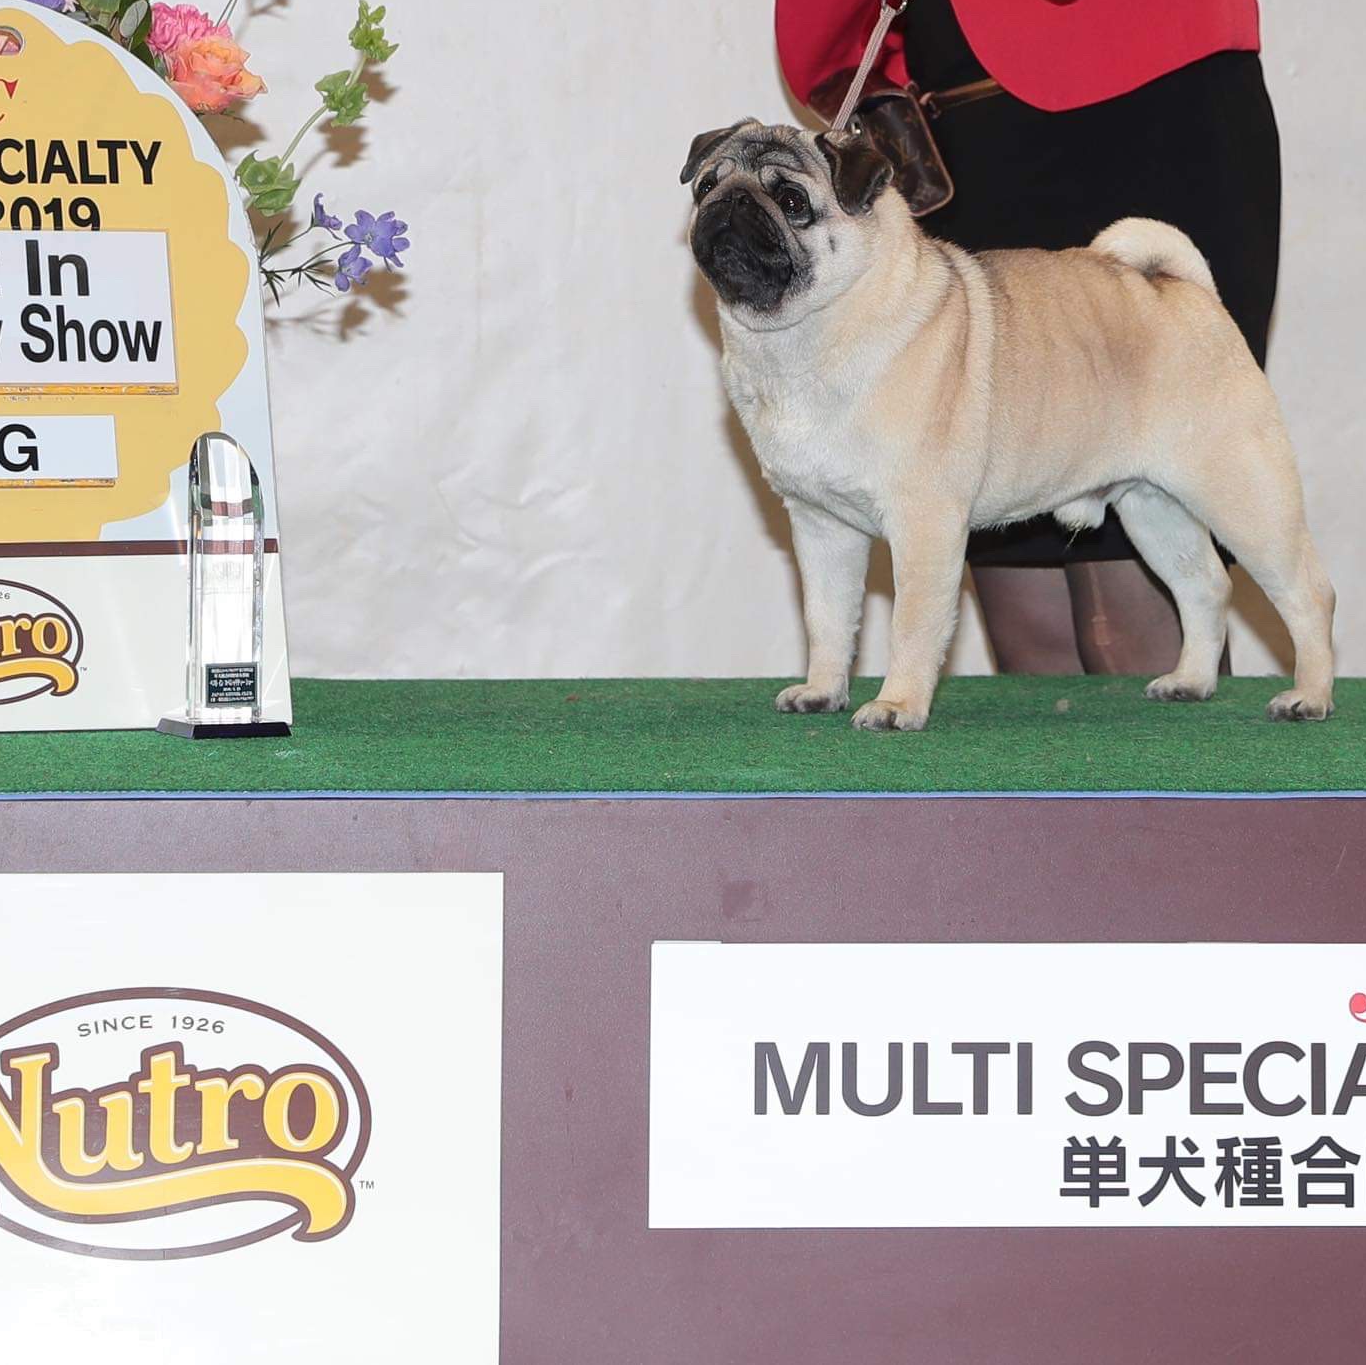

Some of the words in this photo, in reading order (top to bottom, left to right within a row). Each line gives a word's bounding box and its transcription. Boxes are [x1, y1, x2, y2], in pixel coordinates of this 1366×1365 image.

[25, 240, 90, 297] In
[20, 303, 163, 363] Show
[77, 1014, 153, 1038] SINCE
[170, 1015, 226, 1035] 1926
[754, 1042, 1033, 1117] MULTI
